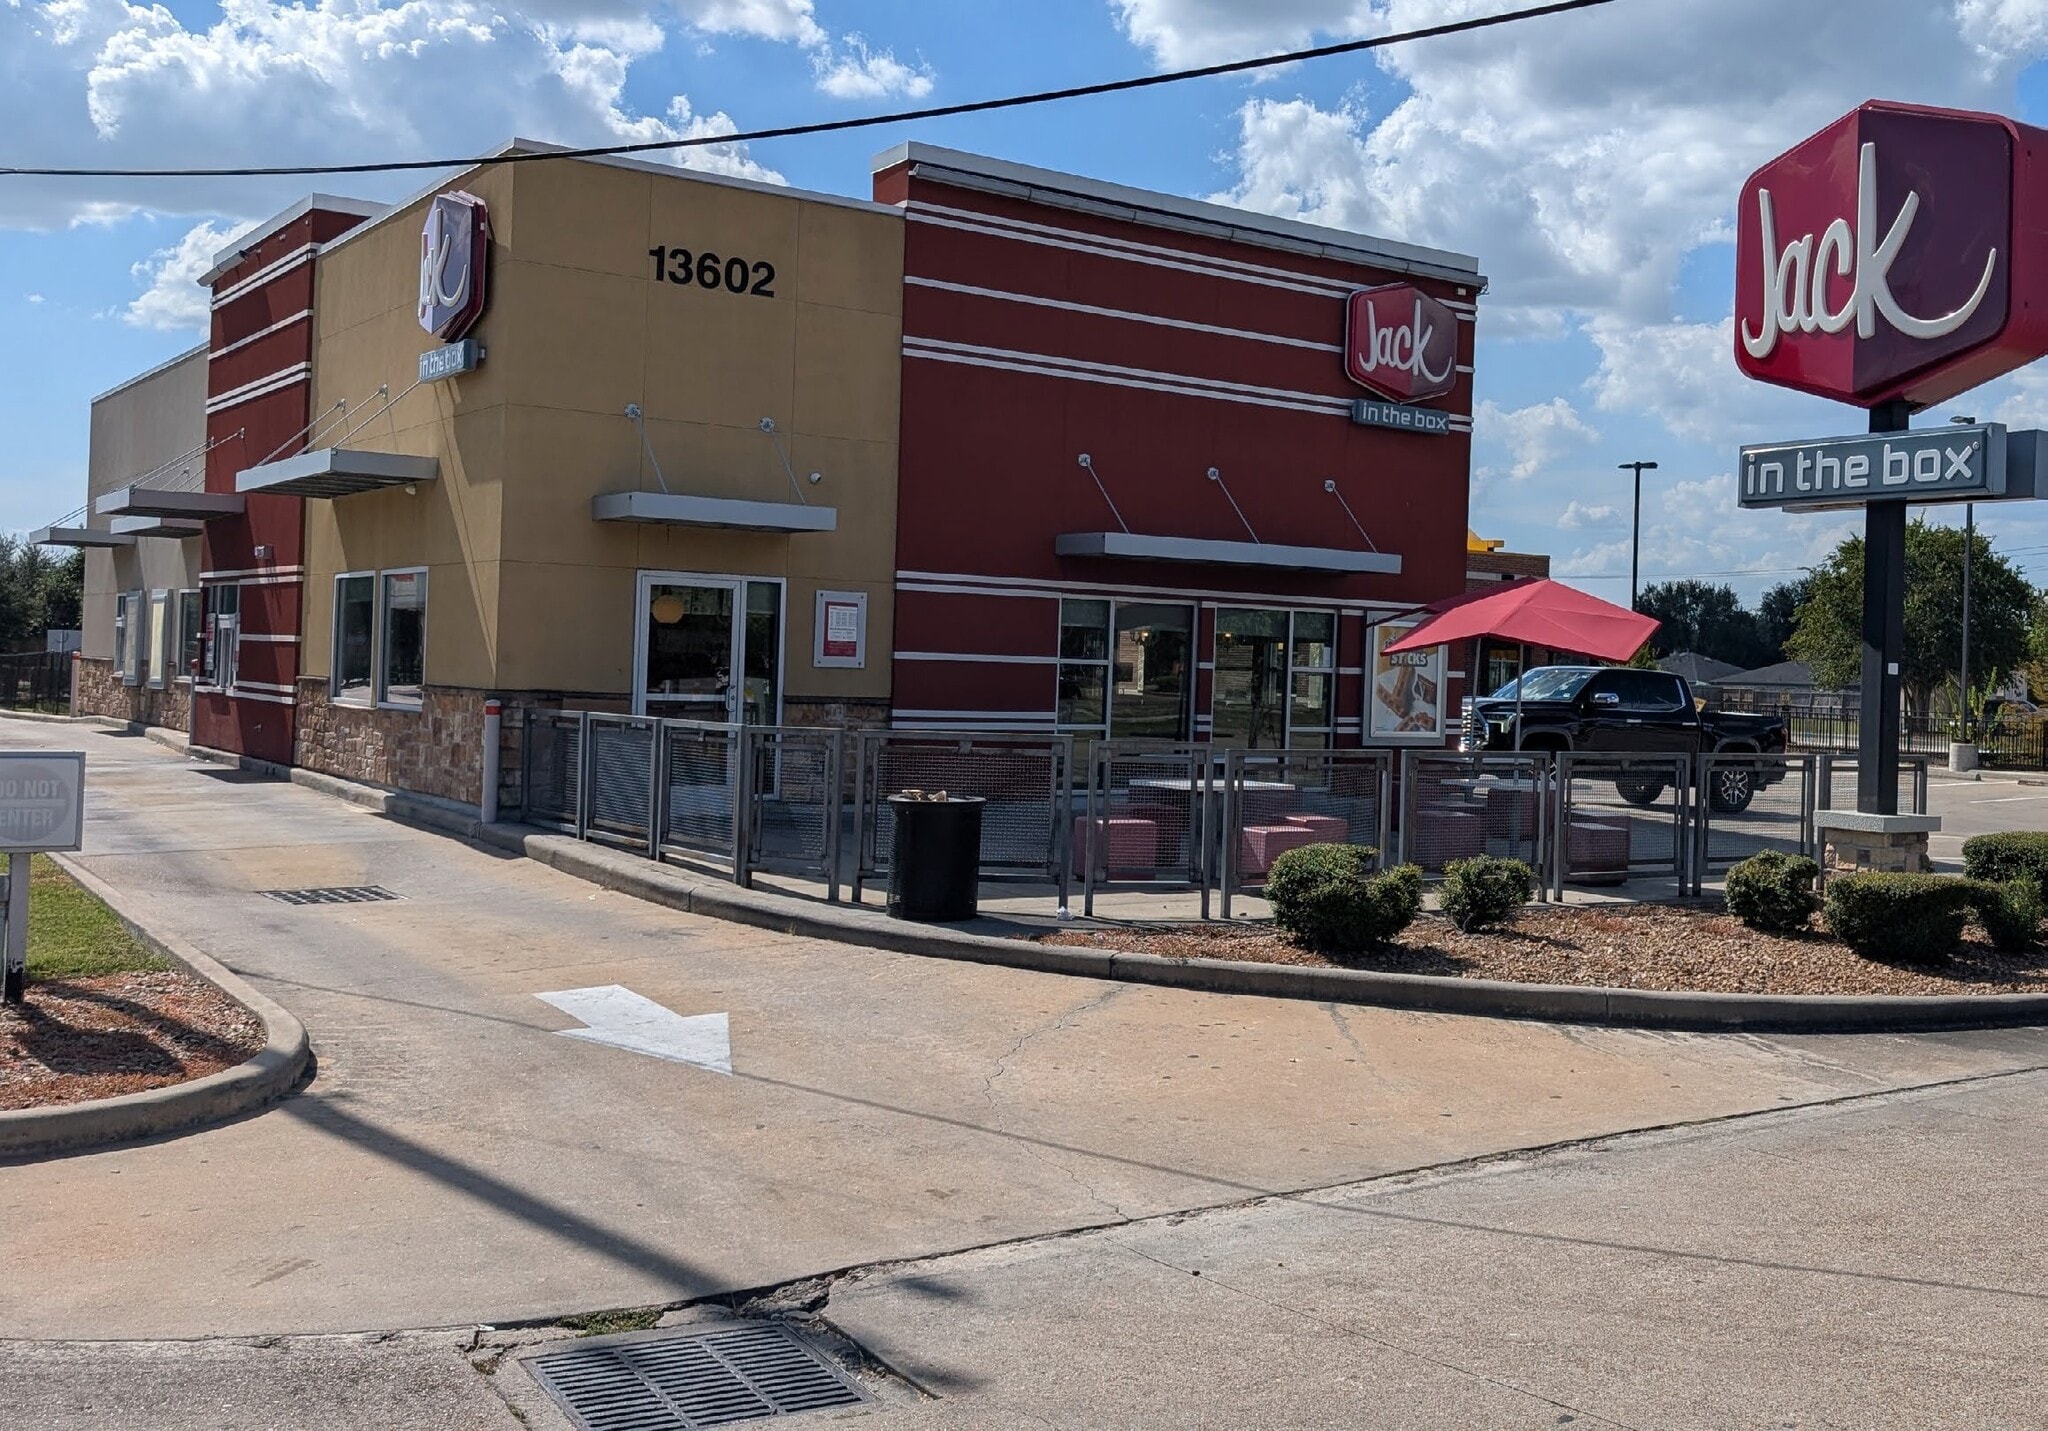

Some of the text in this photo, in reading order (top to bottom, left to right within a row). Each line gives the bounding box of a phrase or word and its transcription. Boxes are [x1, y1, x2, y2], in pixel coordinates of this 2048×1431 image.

[649, 245, 775, 297] 13602
[1741, 142, 1996, 358] Jack
[430, 352, 445, 374] the
[445, 347, 463, 369] box
[1359, 299, 1452, 383] Jack
[1362, 402, 1446, 430] in the box
[1747, 444, 1972, 494] in the box
[24, 779, 59, 798] NOT
